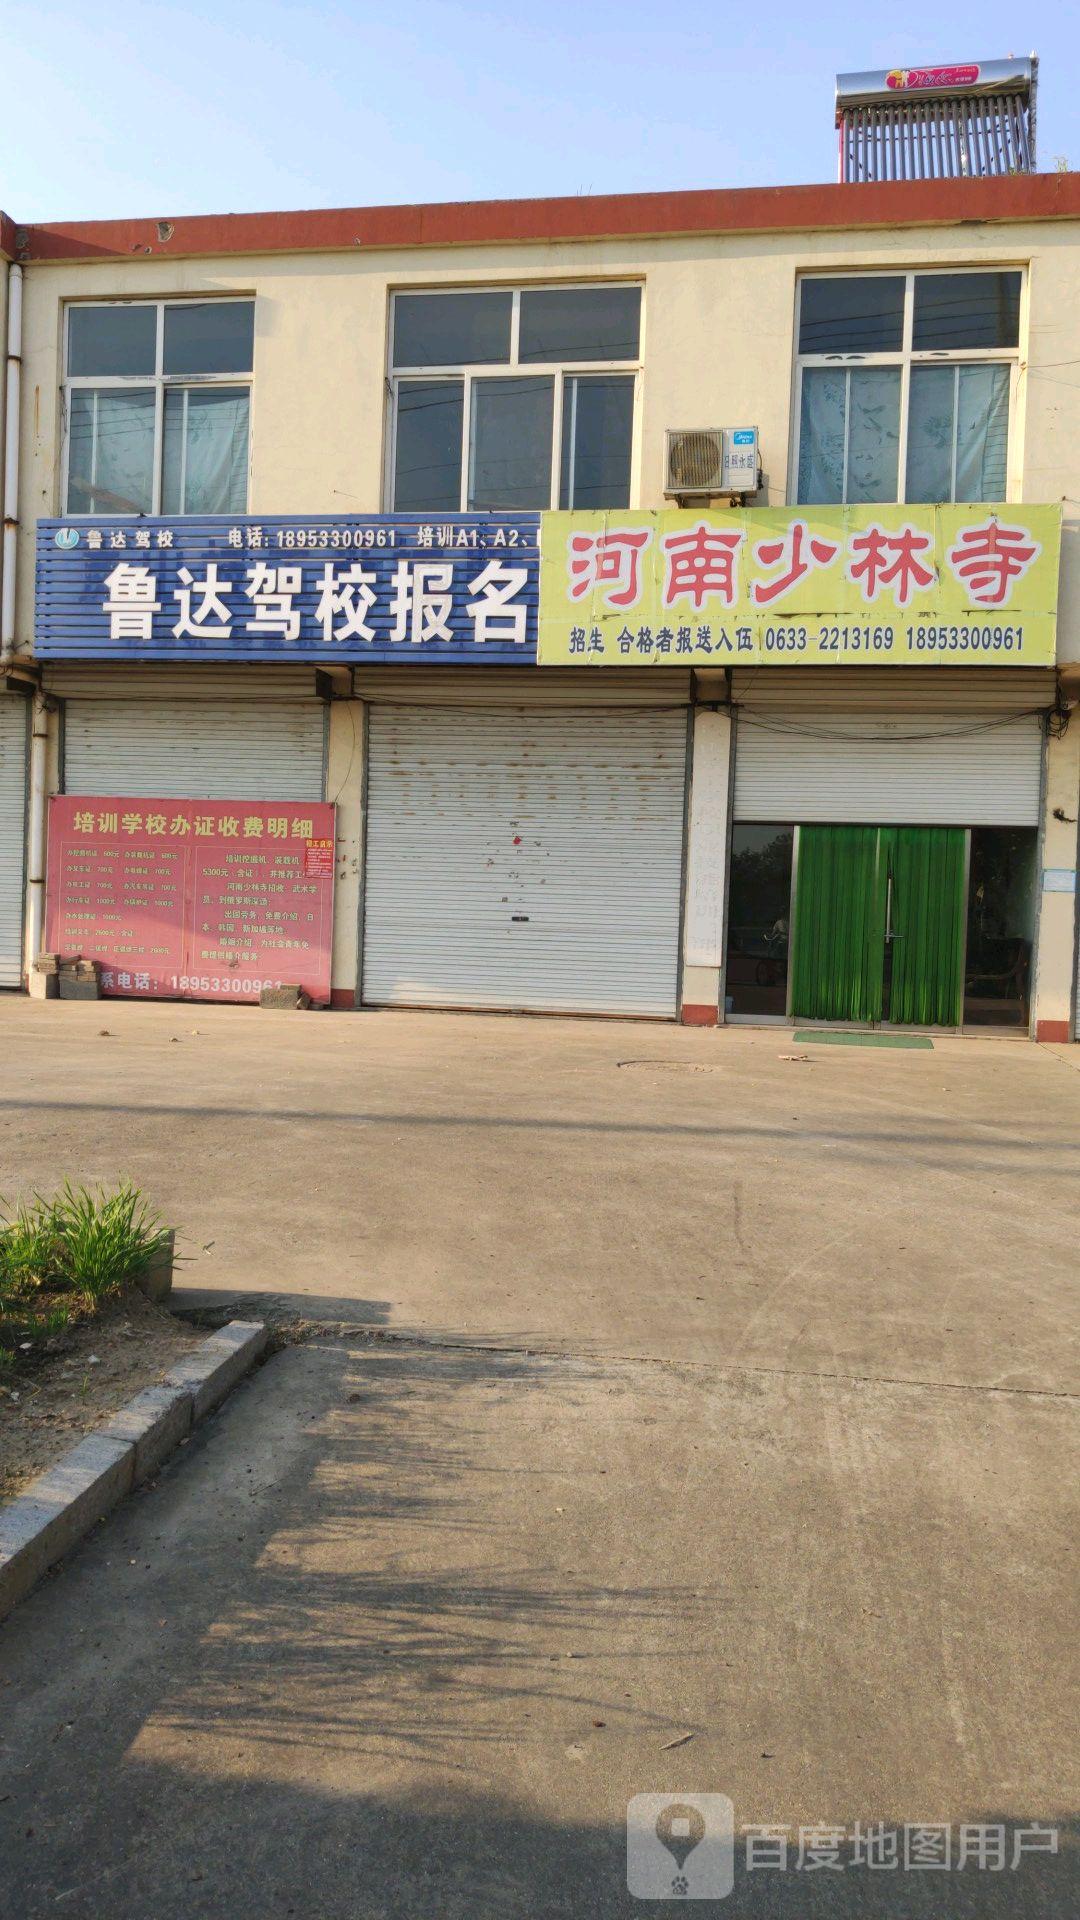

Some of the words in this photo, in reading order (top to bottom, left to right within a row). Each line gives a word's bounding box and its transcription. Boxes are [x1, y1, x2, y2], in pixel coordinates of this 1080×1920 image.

[87, 529, 173, 549] 鲁达驾校
[570, 522, 1037, 606] 河南少林寺
[102, 561, 529, 643] 鲁达驾校报名
[569, 626, 606, 654] 招生
[616, 626, 754, 654] 合格者报送入伍
[765, 626, 894, 653] 0633-2213169
[906, 626, 1024, 652] 18953300961
[74, 812, 314, 839] 培训学校办证收费明细
